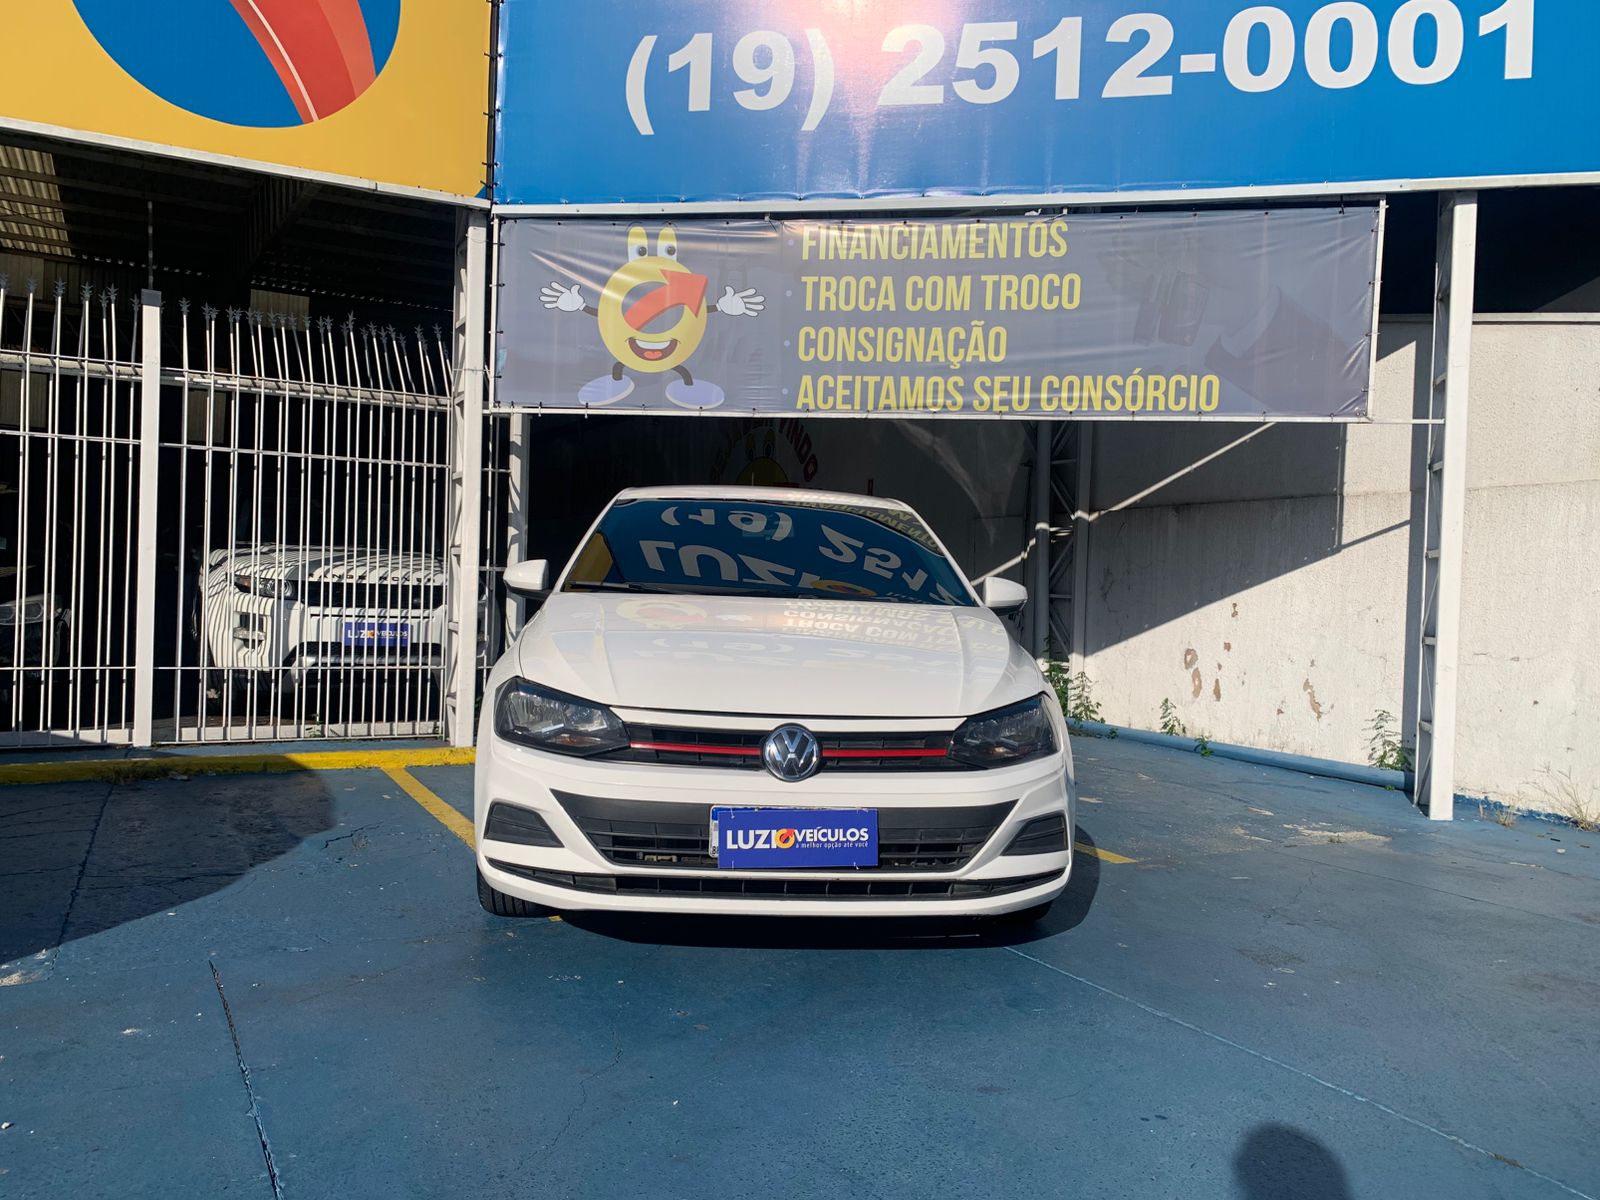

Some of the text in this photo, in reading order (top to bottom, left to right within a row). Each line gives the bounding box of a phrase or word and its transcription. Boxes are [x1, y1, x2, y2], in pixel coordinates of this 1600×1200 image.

[625, 0, 1535, 135] (19) 2512-0001
[801, 220, 1069, 261] FINANCIAMENTOS
[802, 273, 1082, 312] TROCA COM TROCO
[797, 320, 1008, 370] CONSIGNAÇÃO
[796, 367, 1220, 412] ACEITAMOS SEU CONSÓRCIO
[726, 825, 869, 849] LUZIO VEÍCULOS
